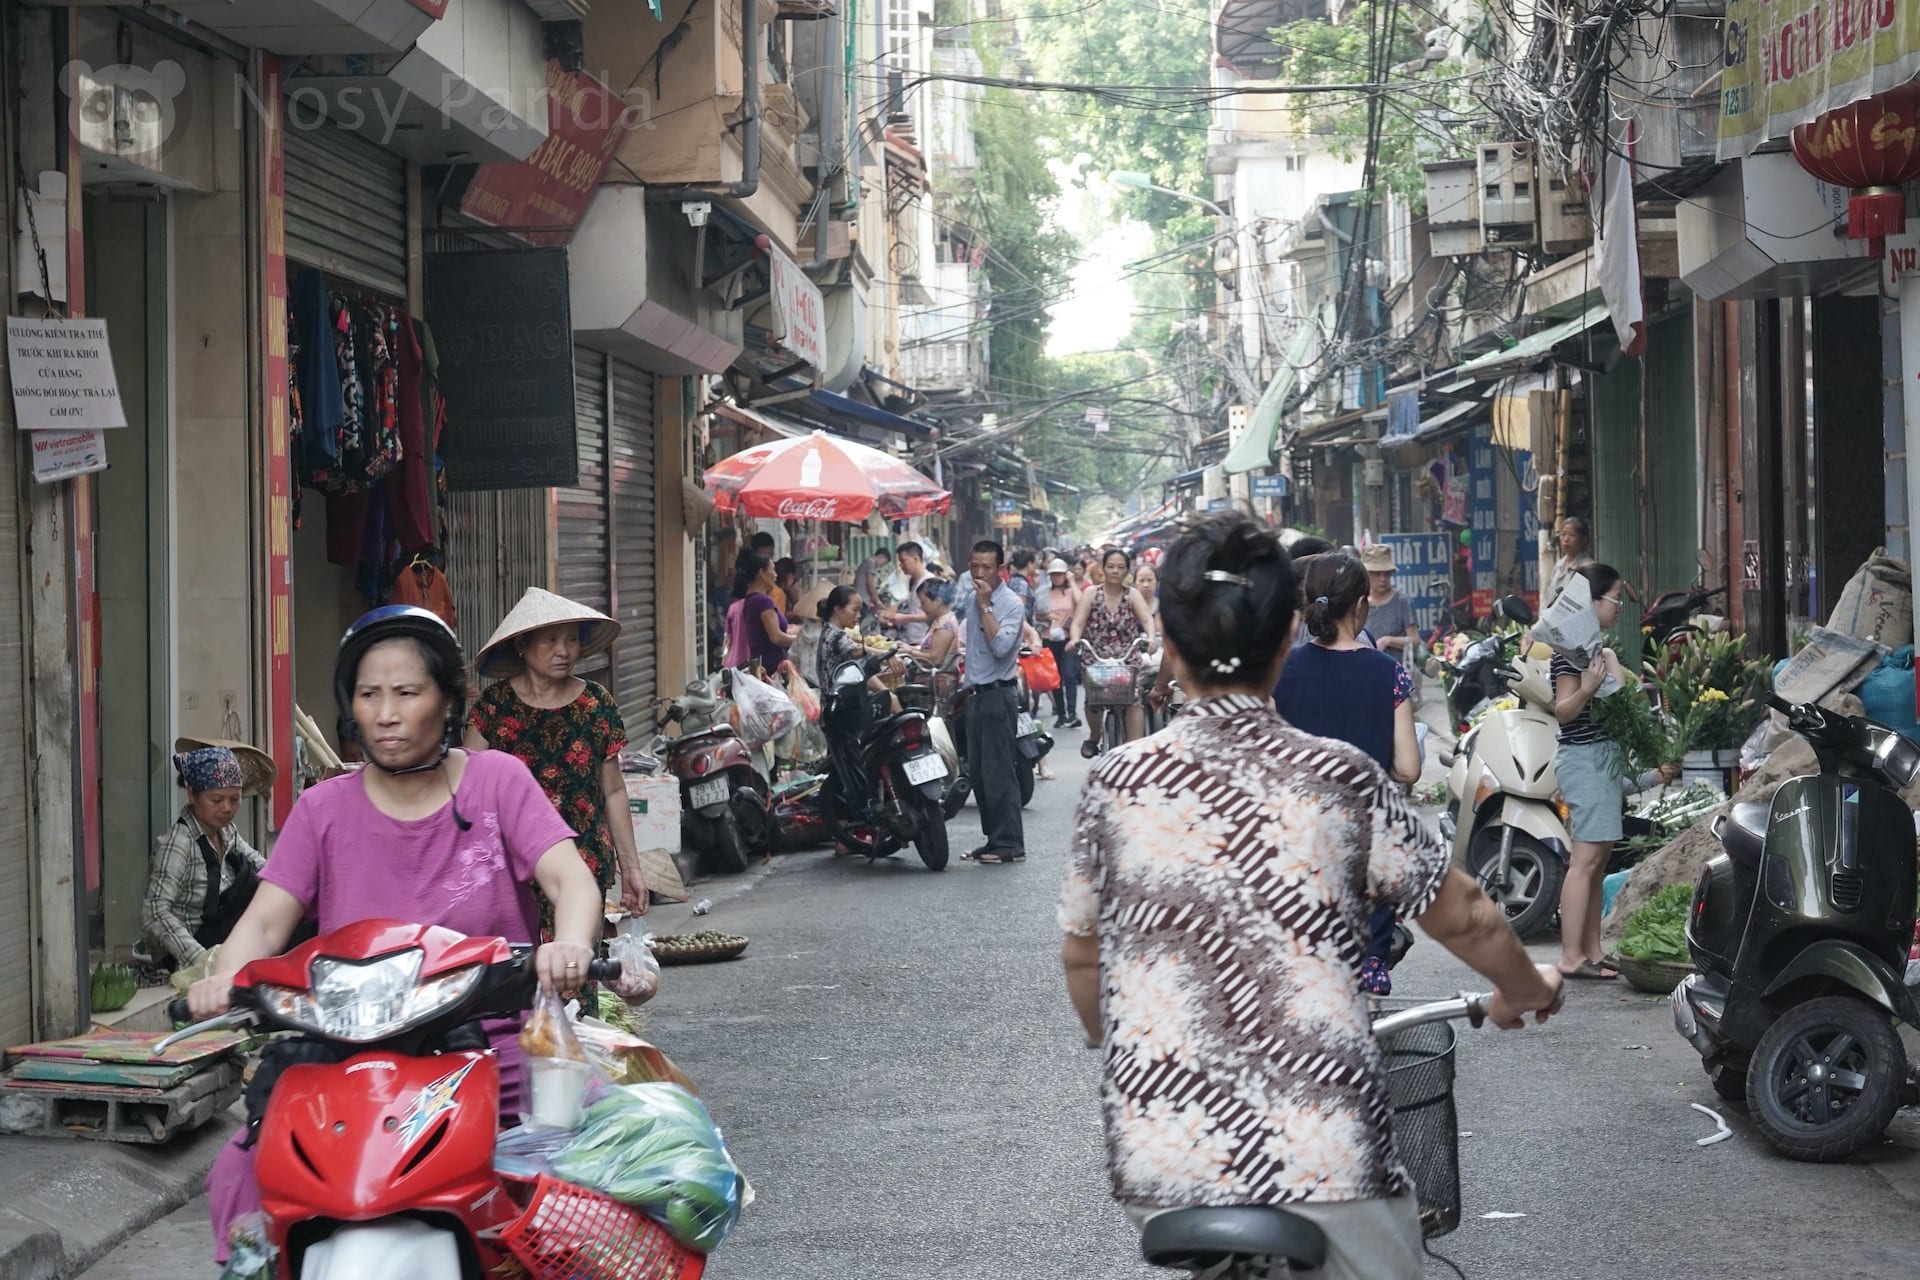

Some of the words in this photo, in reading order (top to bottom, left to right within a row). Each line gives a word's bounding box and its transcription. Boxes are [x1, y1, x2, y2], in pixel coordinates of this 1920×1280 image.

[46, 348, 61, 359] KHI
[63, 348, 75, 359] RA
[1427, 536, 1448, 564] LÀ
[1774, 806, 1812, 823] Vespa
